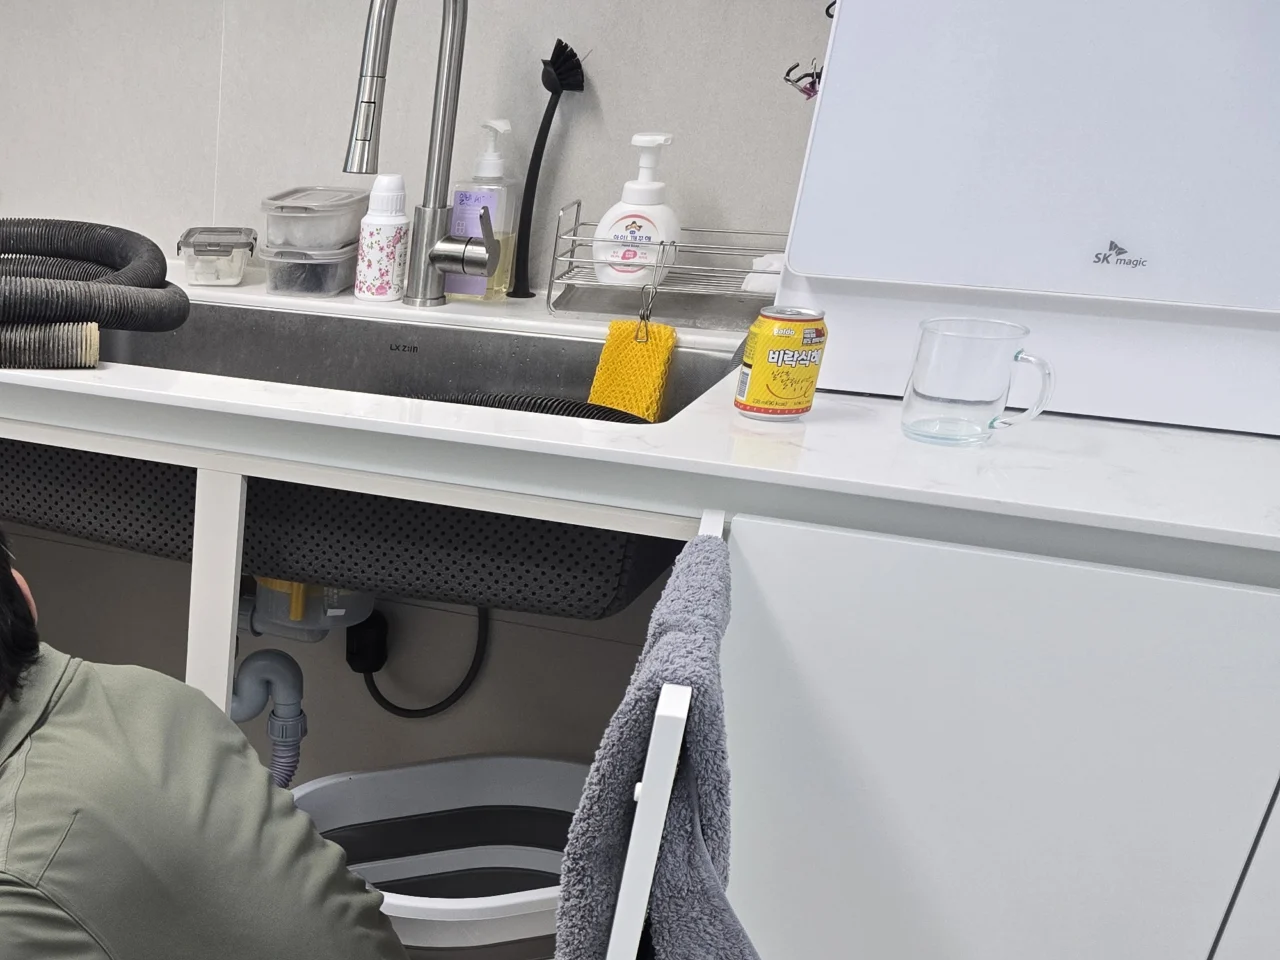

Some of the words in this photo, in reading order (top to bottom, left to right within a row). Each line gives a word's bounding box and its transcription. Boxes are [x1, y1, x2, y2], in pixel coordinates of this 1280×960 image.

[1093, 252, 1112, 264] SK
[1115, 257, 1148, 269] magic
[773, 328, 795, 336] paldo
